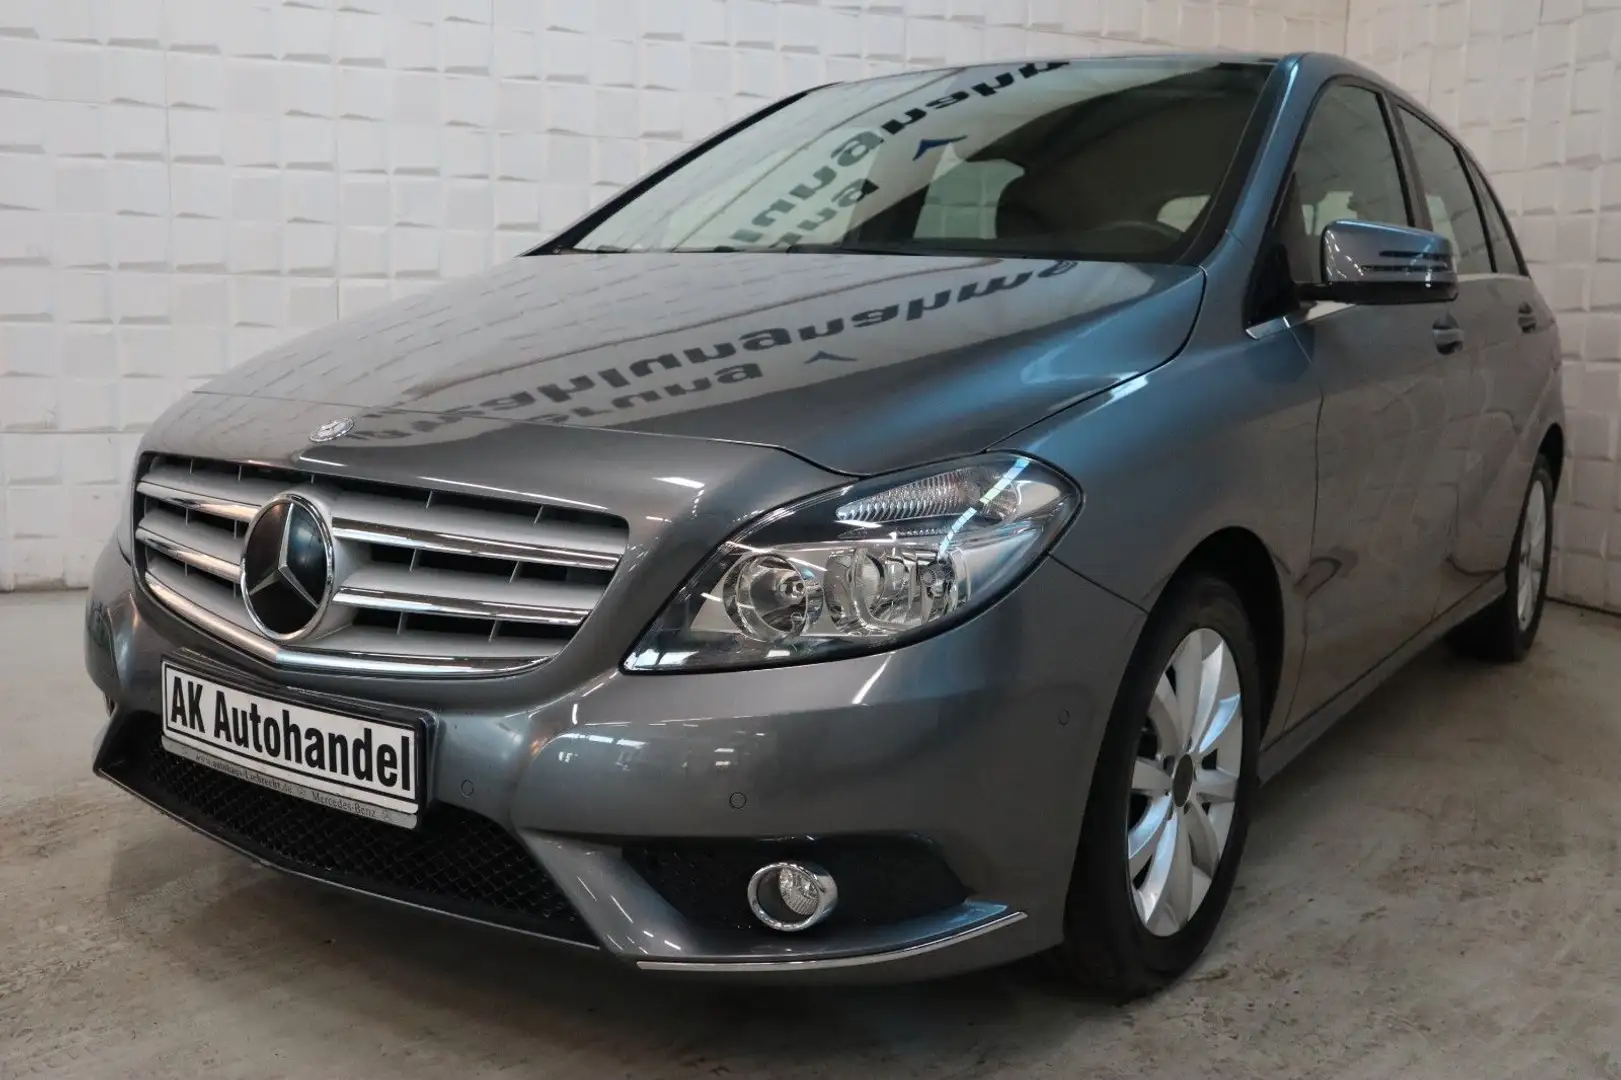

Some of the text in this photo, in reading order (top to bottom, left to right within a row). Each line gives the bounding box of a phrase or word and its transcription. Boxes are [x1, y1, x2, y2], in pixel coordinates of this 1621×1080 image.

[171, 675, 411, 791] AK Autohandel
[311, 790, 376, 818] Mercedes-Benz
